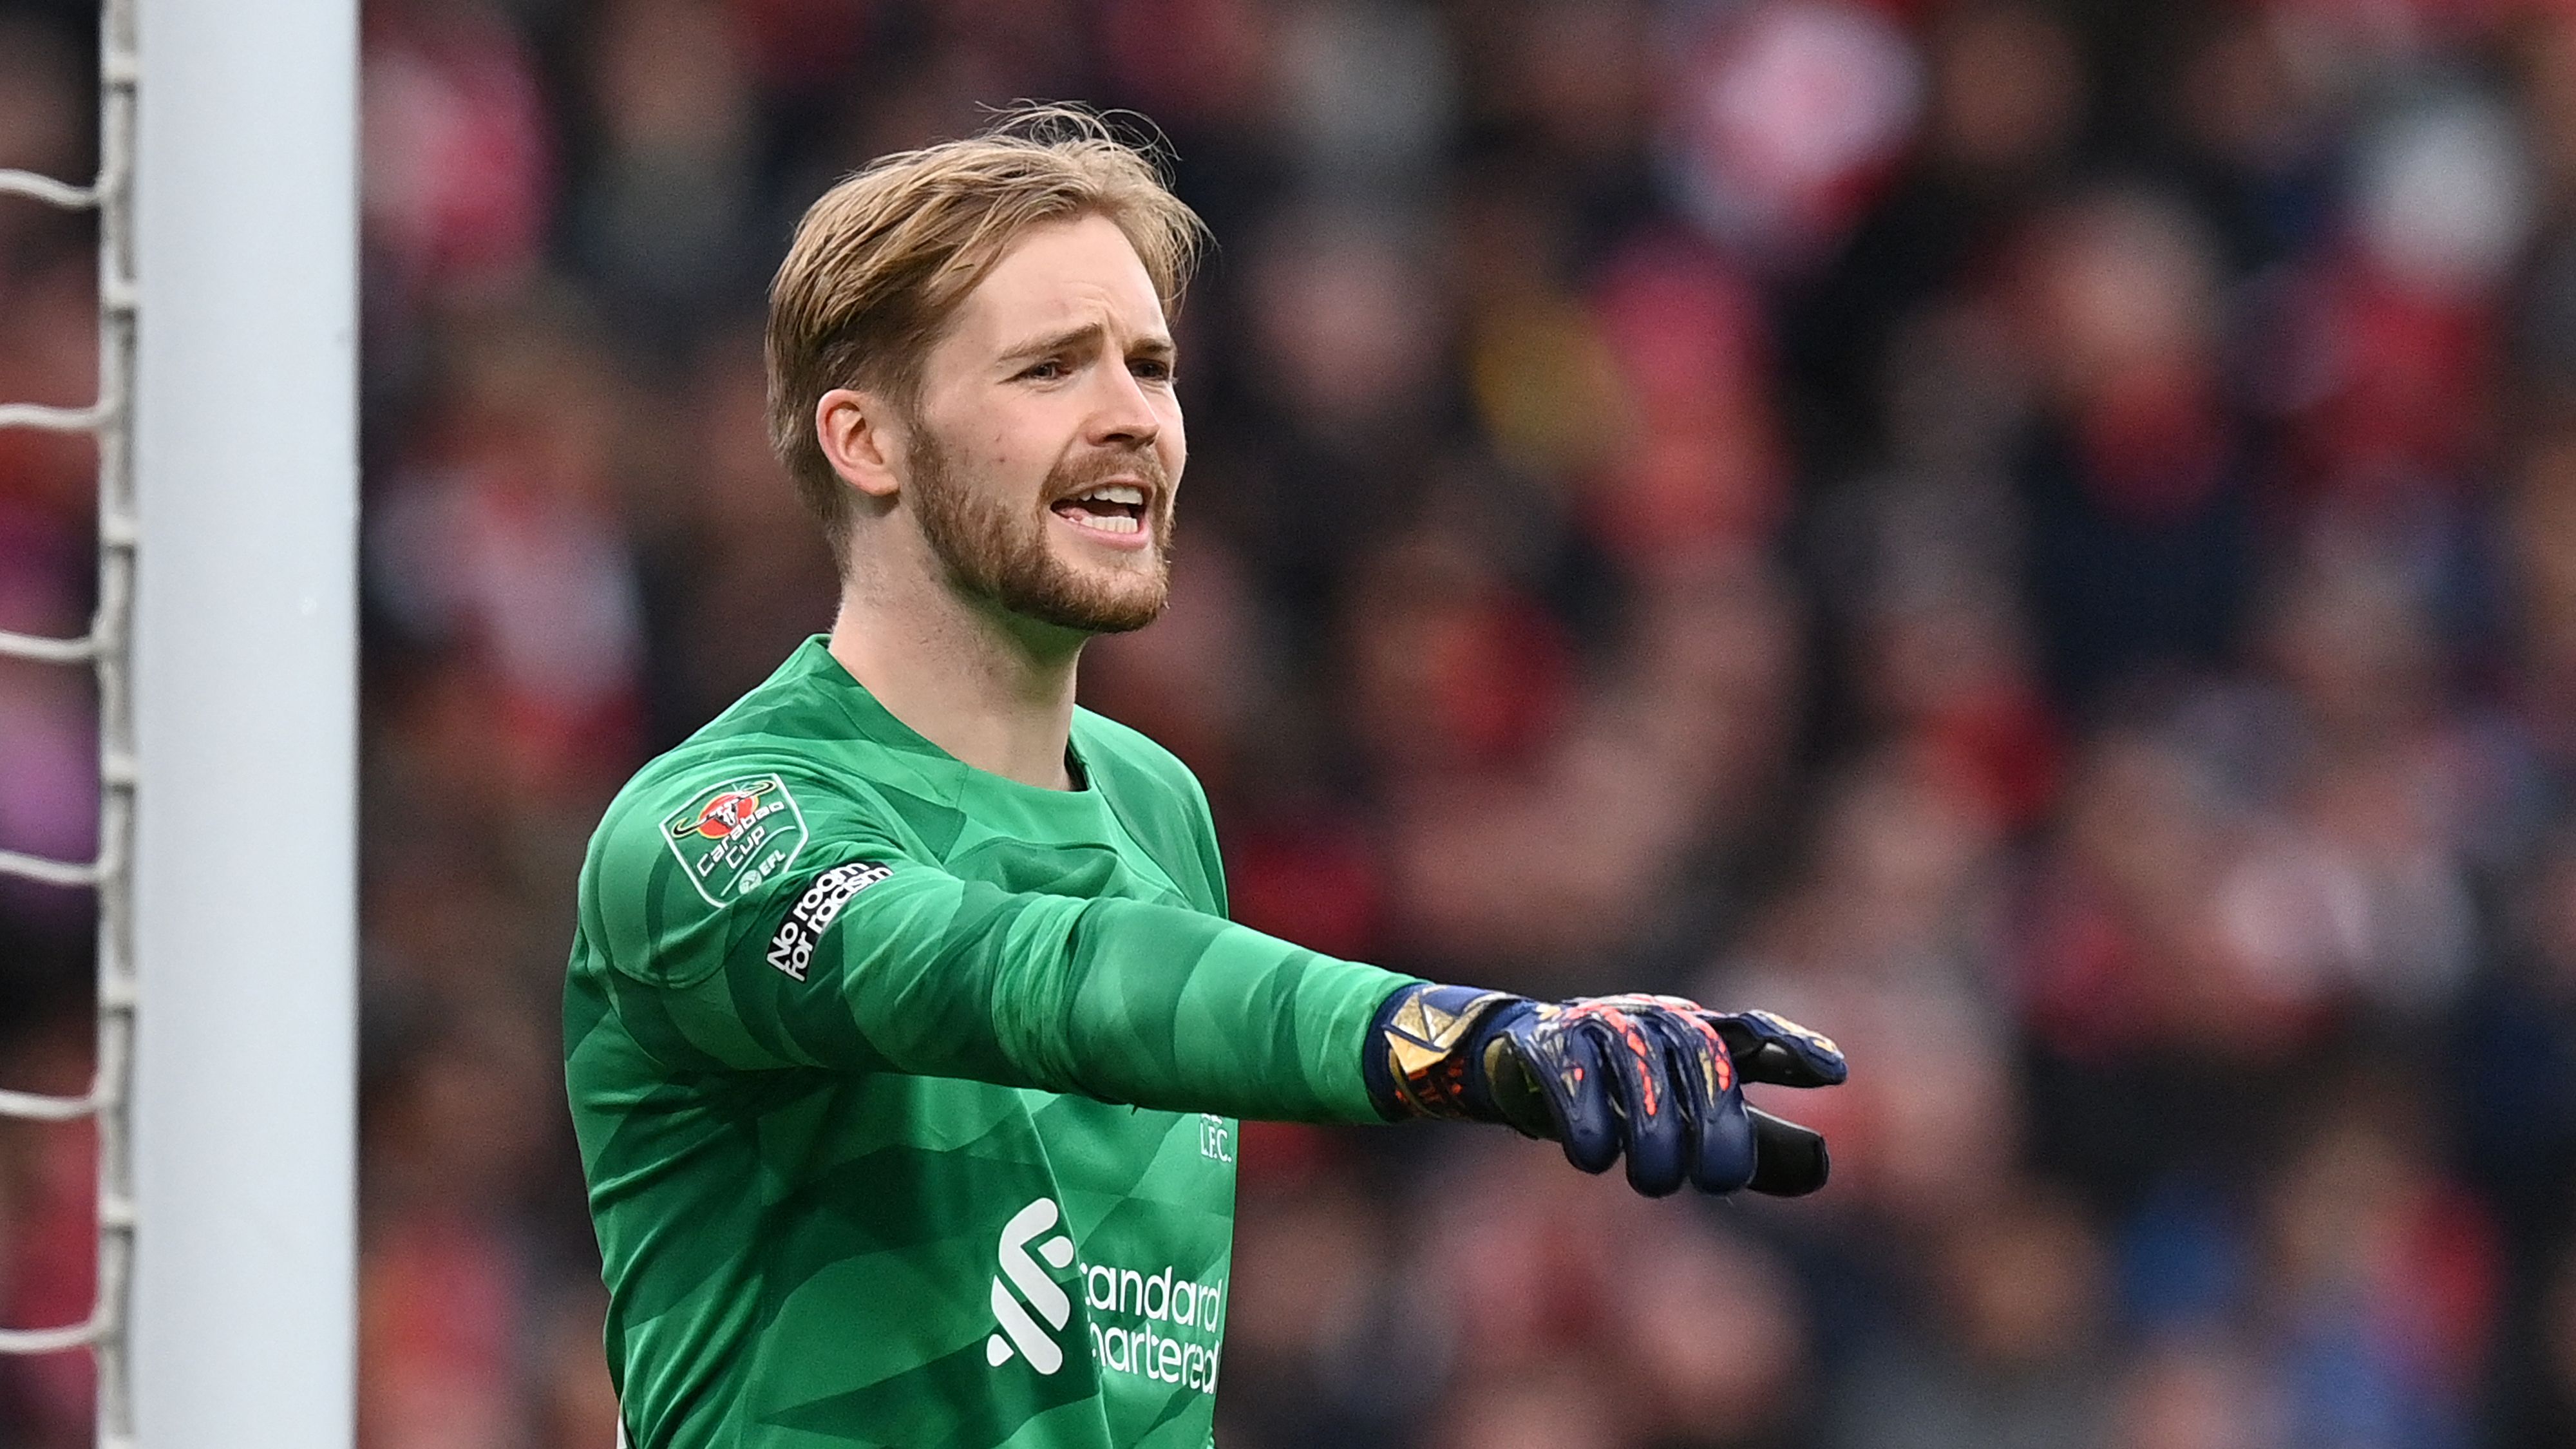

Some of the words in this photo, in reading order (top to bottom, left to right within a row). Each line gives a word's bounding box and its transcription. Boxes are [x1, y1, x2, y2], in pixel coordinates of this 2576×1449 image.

[697, 801, 785, 877] Carabao
[758, 849, 786, 876] EFL
[766, 922, 799, 971] No
[793, 863, 870, 921] room
[784, 931, 813, 982] for
[807, 867, 895, 934] racism
[1079, 1262, 1222, 1333] andard
[1087, 1322, 1220, 1394] hartered
